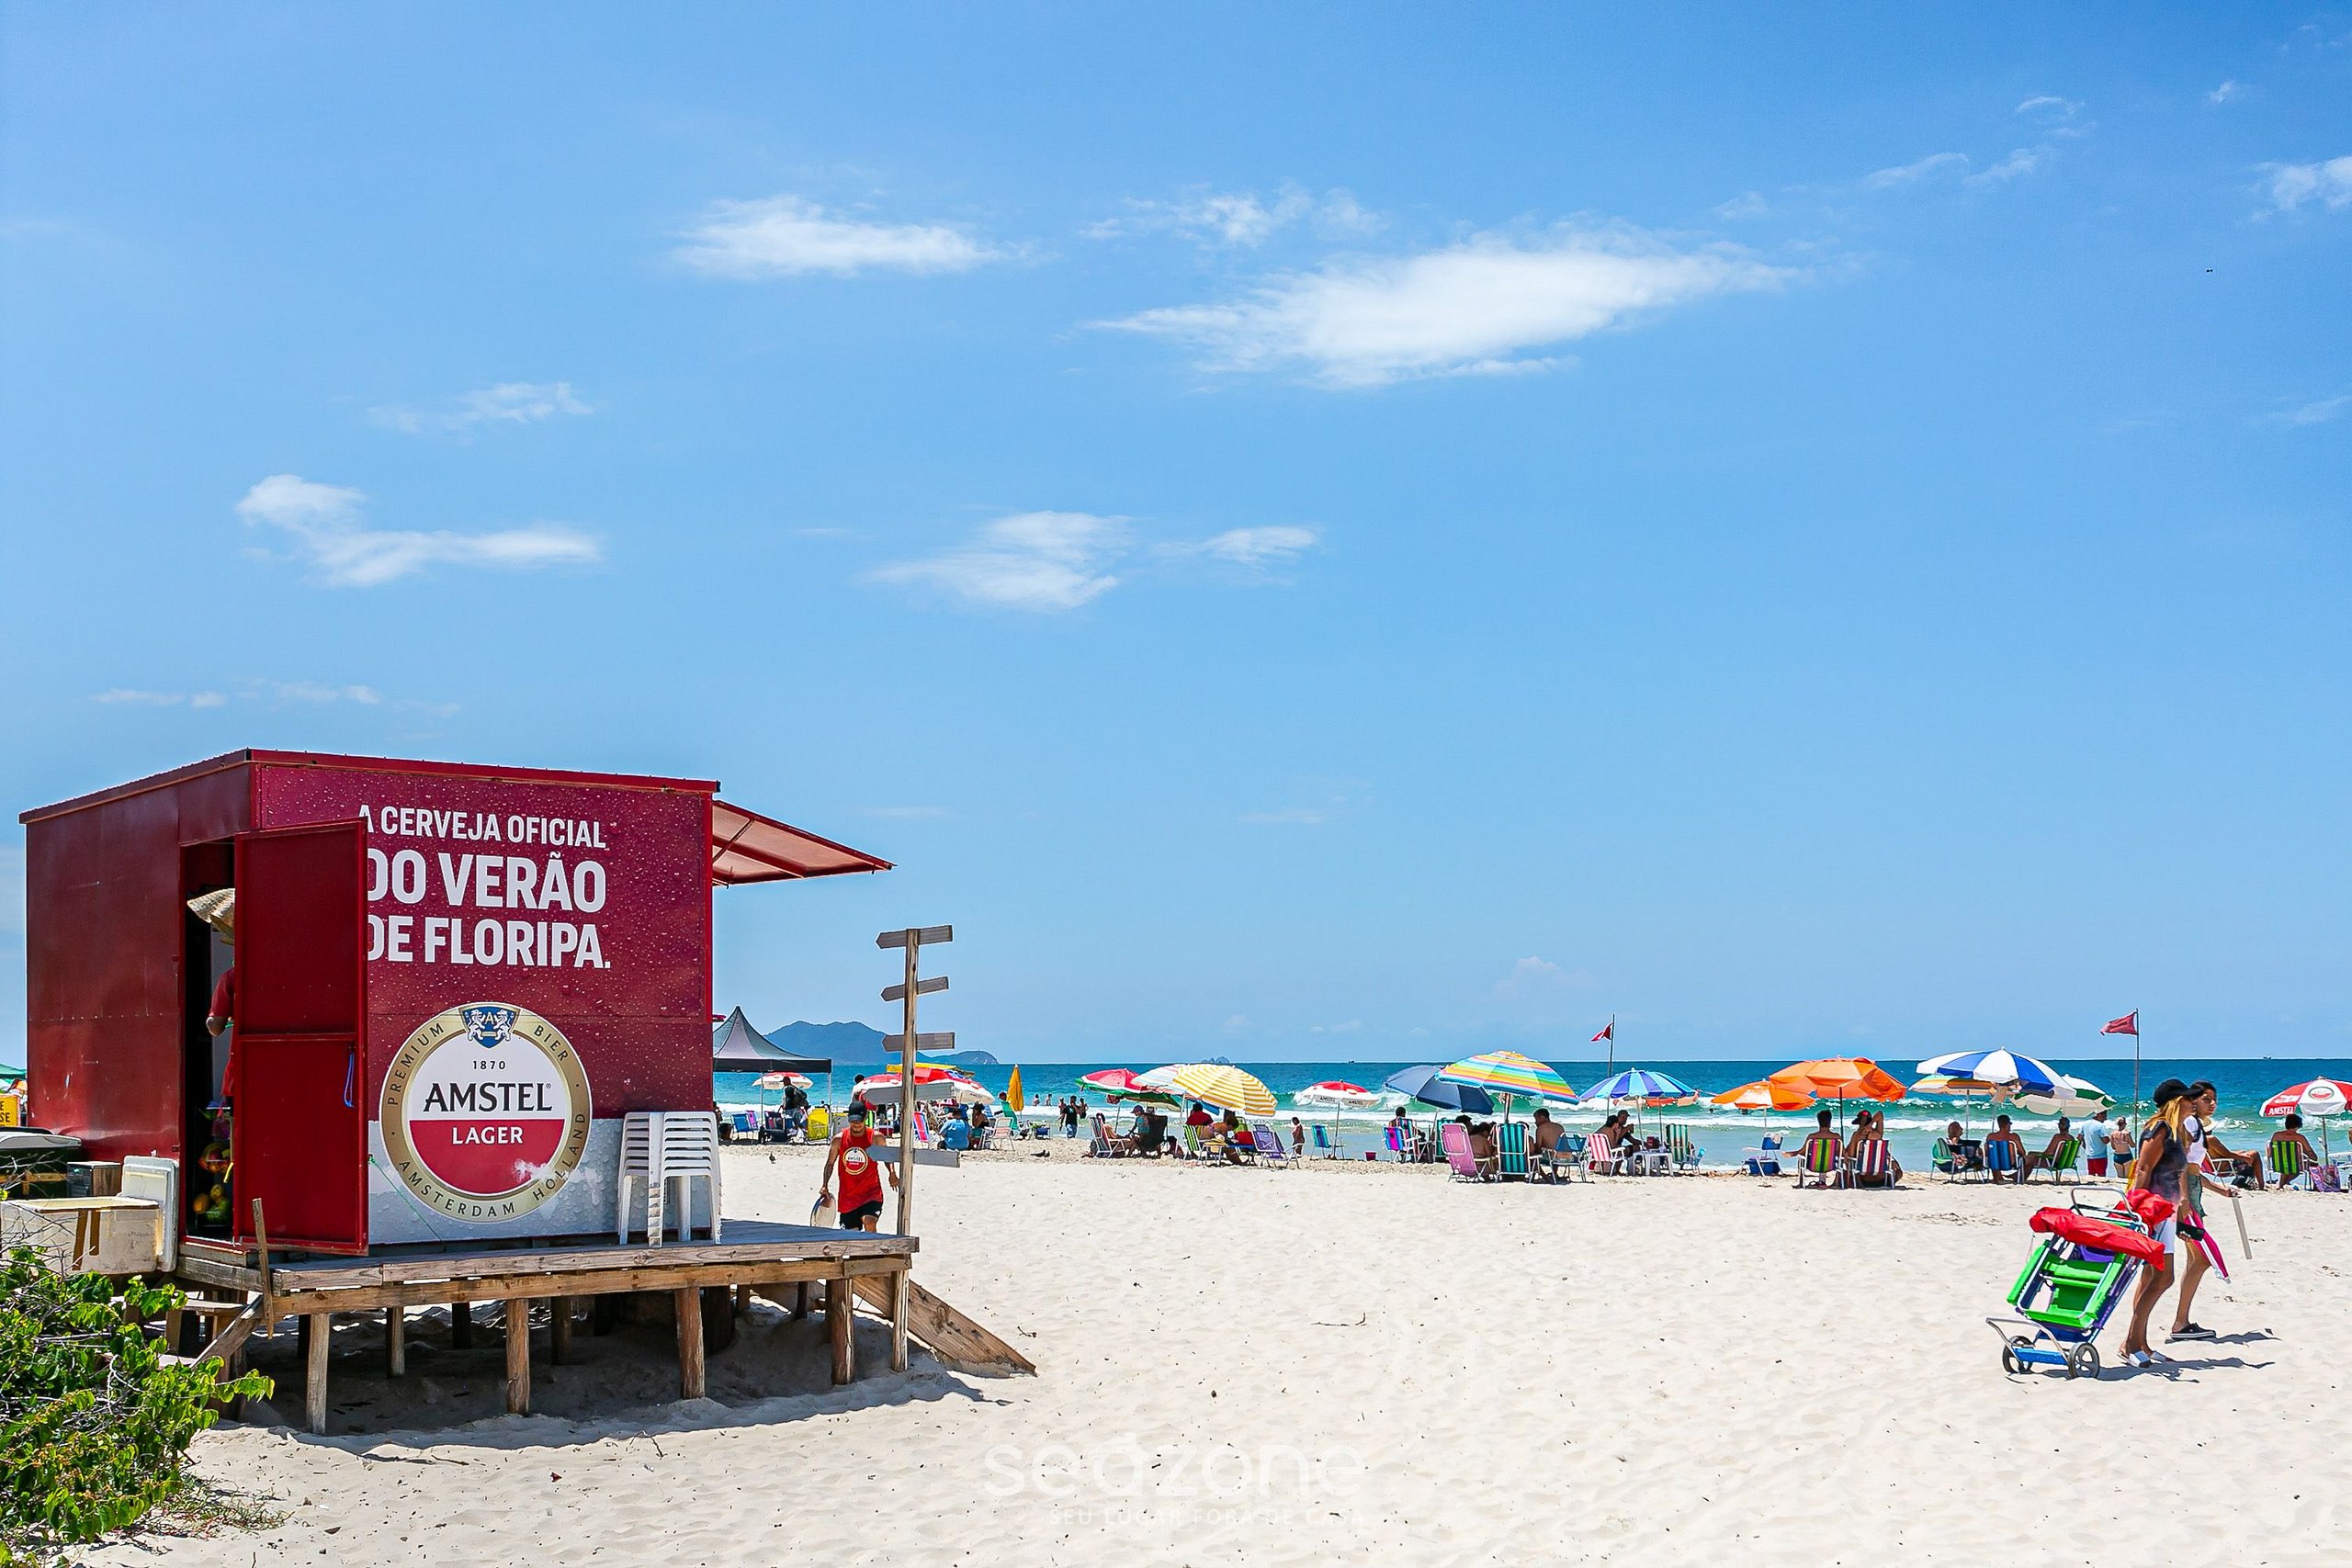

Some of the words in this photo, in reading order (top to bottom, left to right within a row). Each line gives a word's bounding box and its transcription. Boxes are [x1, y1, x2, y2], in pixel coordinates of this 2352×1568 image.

[357, 804, 374, 833] A
[380, 806, 502, 841] CERVEJA
[507, 814, 606, 849] OFICIAL
[438, 852, 606, 913] VERÃO
[424, 917, 612, 969] FLORIPA.
[388, 1021, 445, 1107] PREMIUM
[533, 1024, 569, 1063] BIER
[471, 1059, 506, 1071] 1870
[2268, 1106, 2295, 1115] AMSTEL
[451, 1125, 524, 1145] LAGER
[399, 1160, 516, 1218] AMSTERDAM
[533, 1111, 586, 1202] HOLLAND
